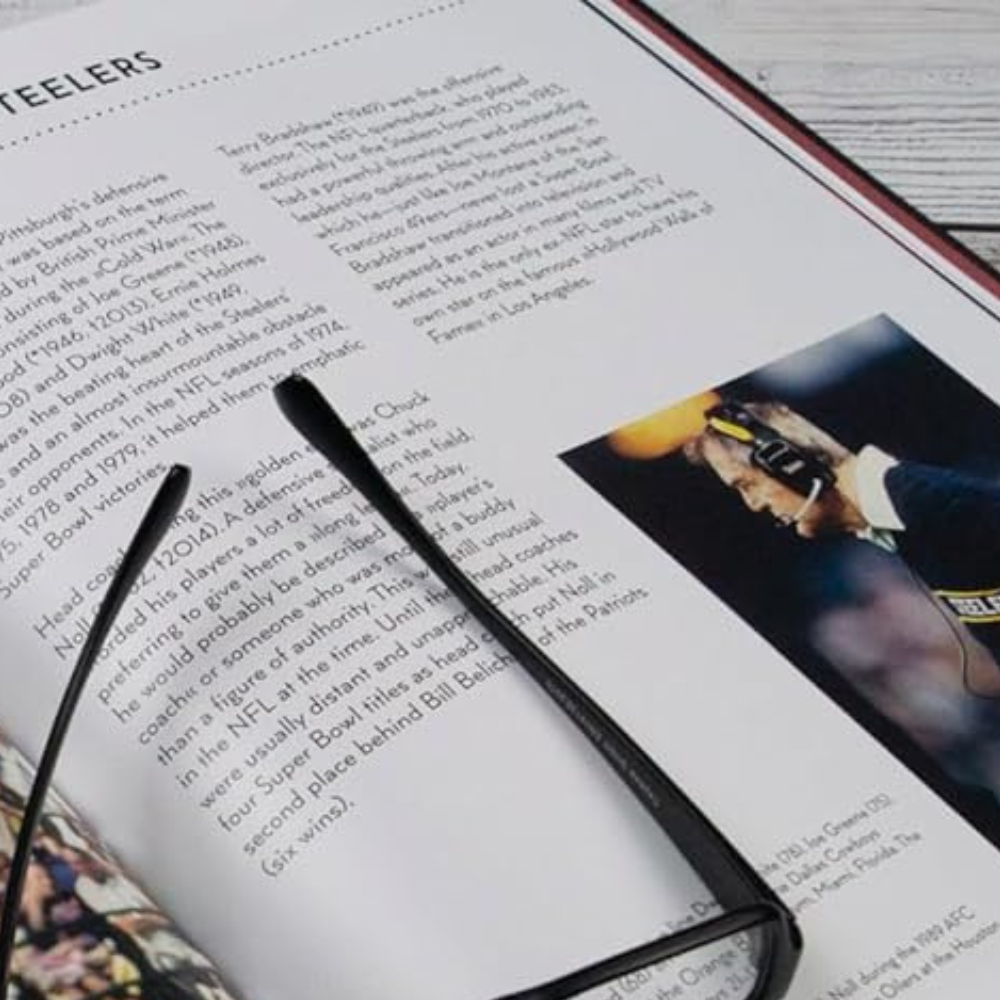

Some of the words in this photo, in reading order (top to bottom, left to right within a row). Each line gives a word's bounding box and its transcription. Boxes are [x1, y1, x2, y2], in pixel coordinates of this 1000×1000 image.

[6, 247, 41, 266] was
[38, 220, 92, 250] based
[117, 204, 146, 218] the
[147, 189, 188, 207] term
[92, 174, 167, 205] defensive
[10, 274, 38, 289] by
[35, 245, 96, 276] British
[93, 227, 148, 250] Prime
[145, 201, 215, 230] Minister
[89, 288, 121, 305] Joe
[120, 261, 187, 289] Greene
[150, 280, 199, 303] Ernie
[197, 255, 266, 283] Holmes
[4, 290, 62, 324] during
[59, 277, 89, 293] the
[8, 443, 42, 478] and
[70, 391, 129, 432] almost
[132, 330, 260, 396] insurmountable
[262, 304, 327, 335] obstacle
[29, 405, 60, 427] the
[56, 366, 130, 406] beating
[123, 341, 173, 369] heart
[194, 321, 224, 336] the
[35, 364, 68, 393] and
[65, 333, 134, 371] Dwight
[128, 310, 189, 335] White
[144, 398, 176, 417] the
[174, 373, 221, 400] NFL
[221, 347, 286, 380] seasons
[373, 391, 430, 419] Chuck
[18, 499, 60, 536] 1978
[64, 469, 99, 503] and
[156, 398, 221, 438] helped
[220, 382, 268, 407] them
[196, 487, 233, 510] this
[223, 512, 243, 528] A
[243, 469, 325, 516] defensive
[43, 506, 93, 551] Bowl
[93, 463, 167, 512] victories
[458, 497, 516, 525] buddy
[482, 511, 543, 546] unusual
[515, 530, 579, 563] coaches
[143, 590, 178, 613] his
[179, 546, 243, 594] players
[254, 518, 284, 538] lot
[582, 589, 649, 620] Patriots
[33, 587, 84, 639] Head
[97, 623, 184, 706] preferring
[204, 580, 241, 612] give
[241, 548, 292, 581] them
[111, 700, 140, 724] he
[141, 644, 195, 696] would
[196, 591, 275, 654] probably
[270, 576, 302, 595] be
[303, 522, 386, 578] described
[200, 667, 218, 686] or
[221, 608, 304, 668] someone
[304, 583, 344, 608] who
[345, 562, 382, 585] was
[157, 726, 199, 766] than
[210, 669, 267, 712] figure
[367, 577, 414, 607] This
[226, 699, 277, 738] NFL
[296, 662, 330, 685] the
[330, 633, 380, 662] time.
[374, 598, 425, 632] Until
[200, 769, 243, 808] were
[245, 714, 307, 767] usually
[309, 667, 371, 716] distant
[373, 641, 410, 672] and
[217, 795, 256, 832] four
[254, 748, 311, 795] Super
[308, 706, 363, 749] Bowl
[362, 682, 410, 713] titles
[411, 667, 433, 684] as
[428, 634, 480, 670] head
[244, 788, 306, 855] second
[307, 755, 357, 799] place
[352, 702, 424, 756] behind
[419, 682, 457, 711] Bill
